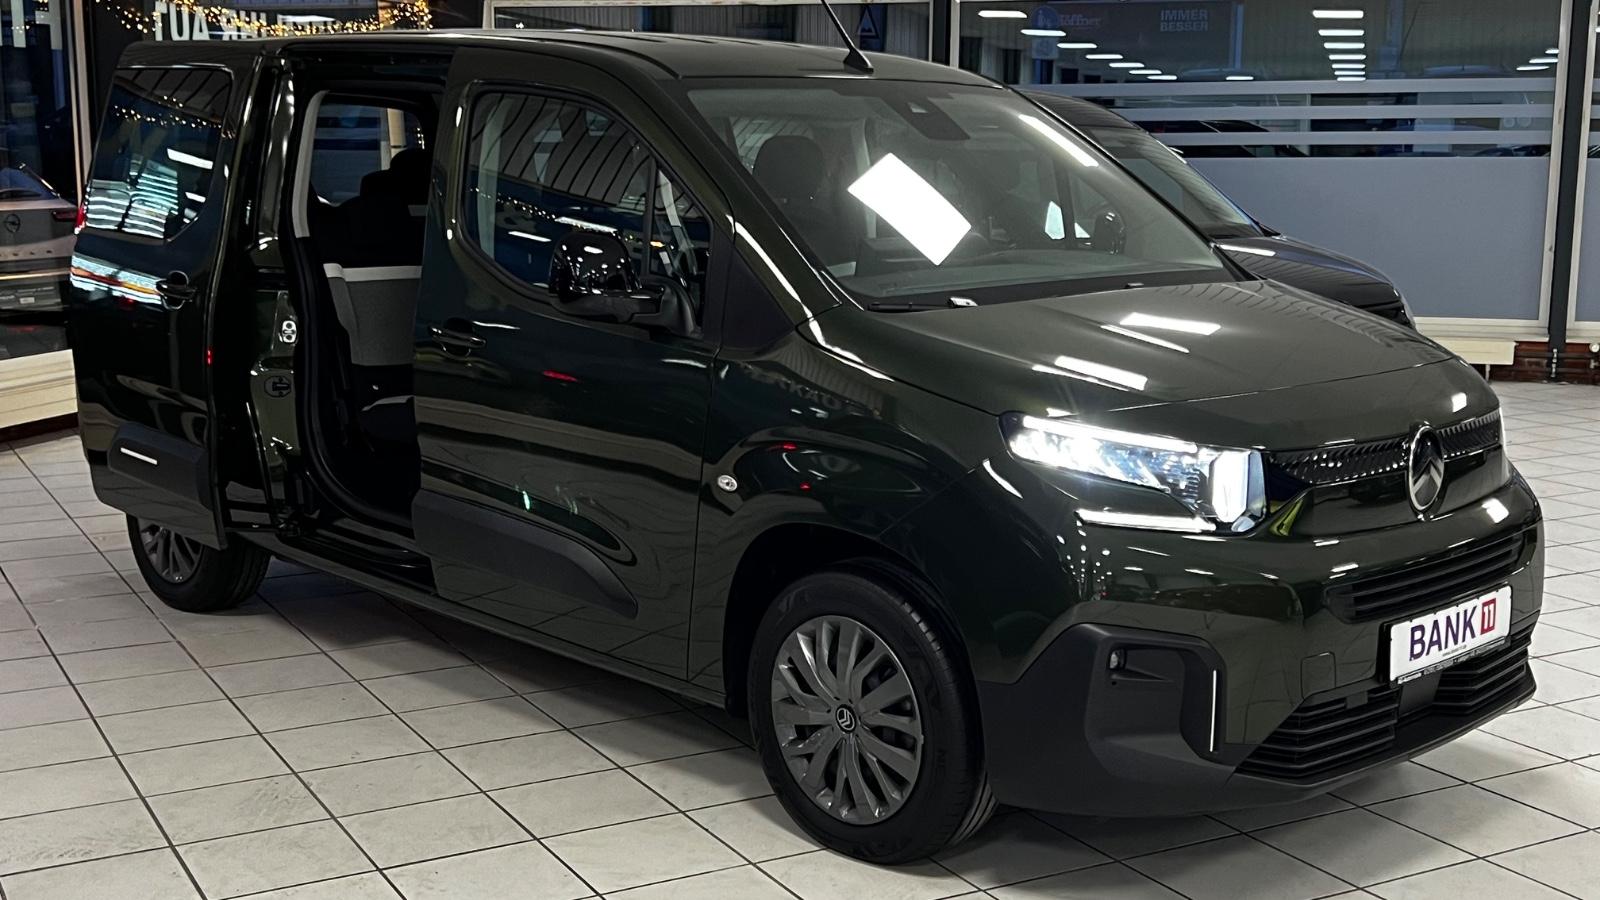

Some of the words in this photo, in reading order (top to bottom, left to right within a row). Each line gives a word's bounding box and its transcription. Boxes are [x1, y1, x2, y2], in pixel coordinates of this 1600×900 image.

[1161, 10, 1208, 21] IMMER
[1160, 21, 1208, 32] BESSER
[1409, 605, 1477, 662] BANK
